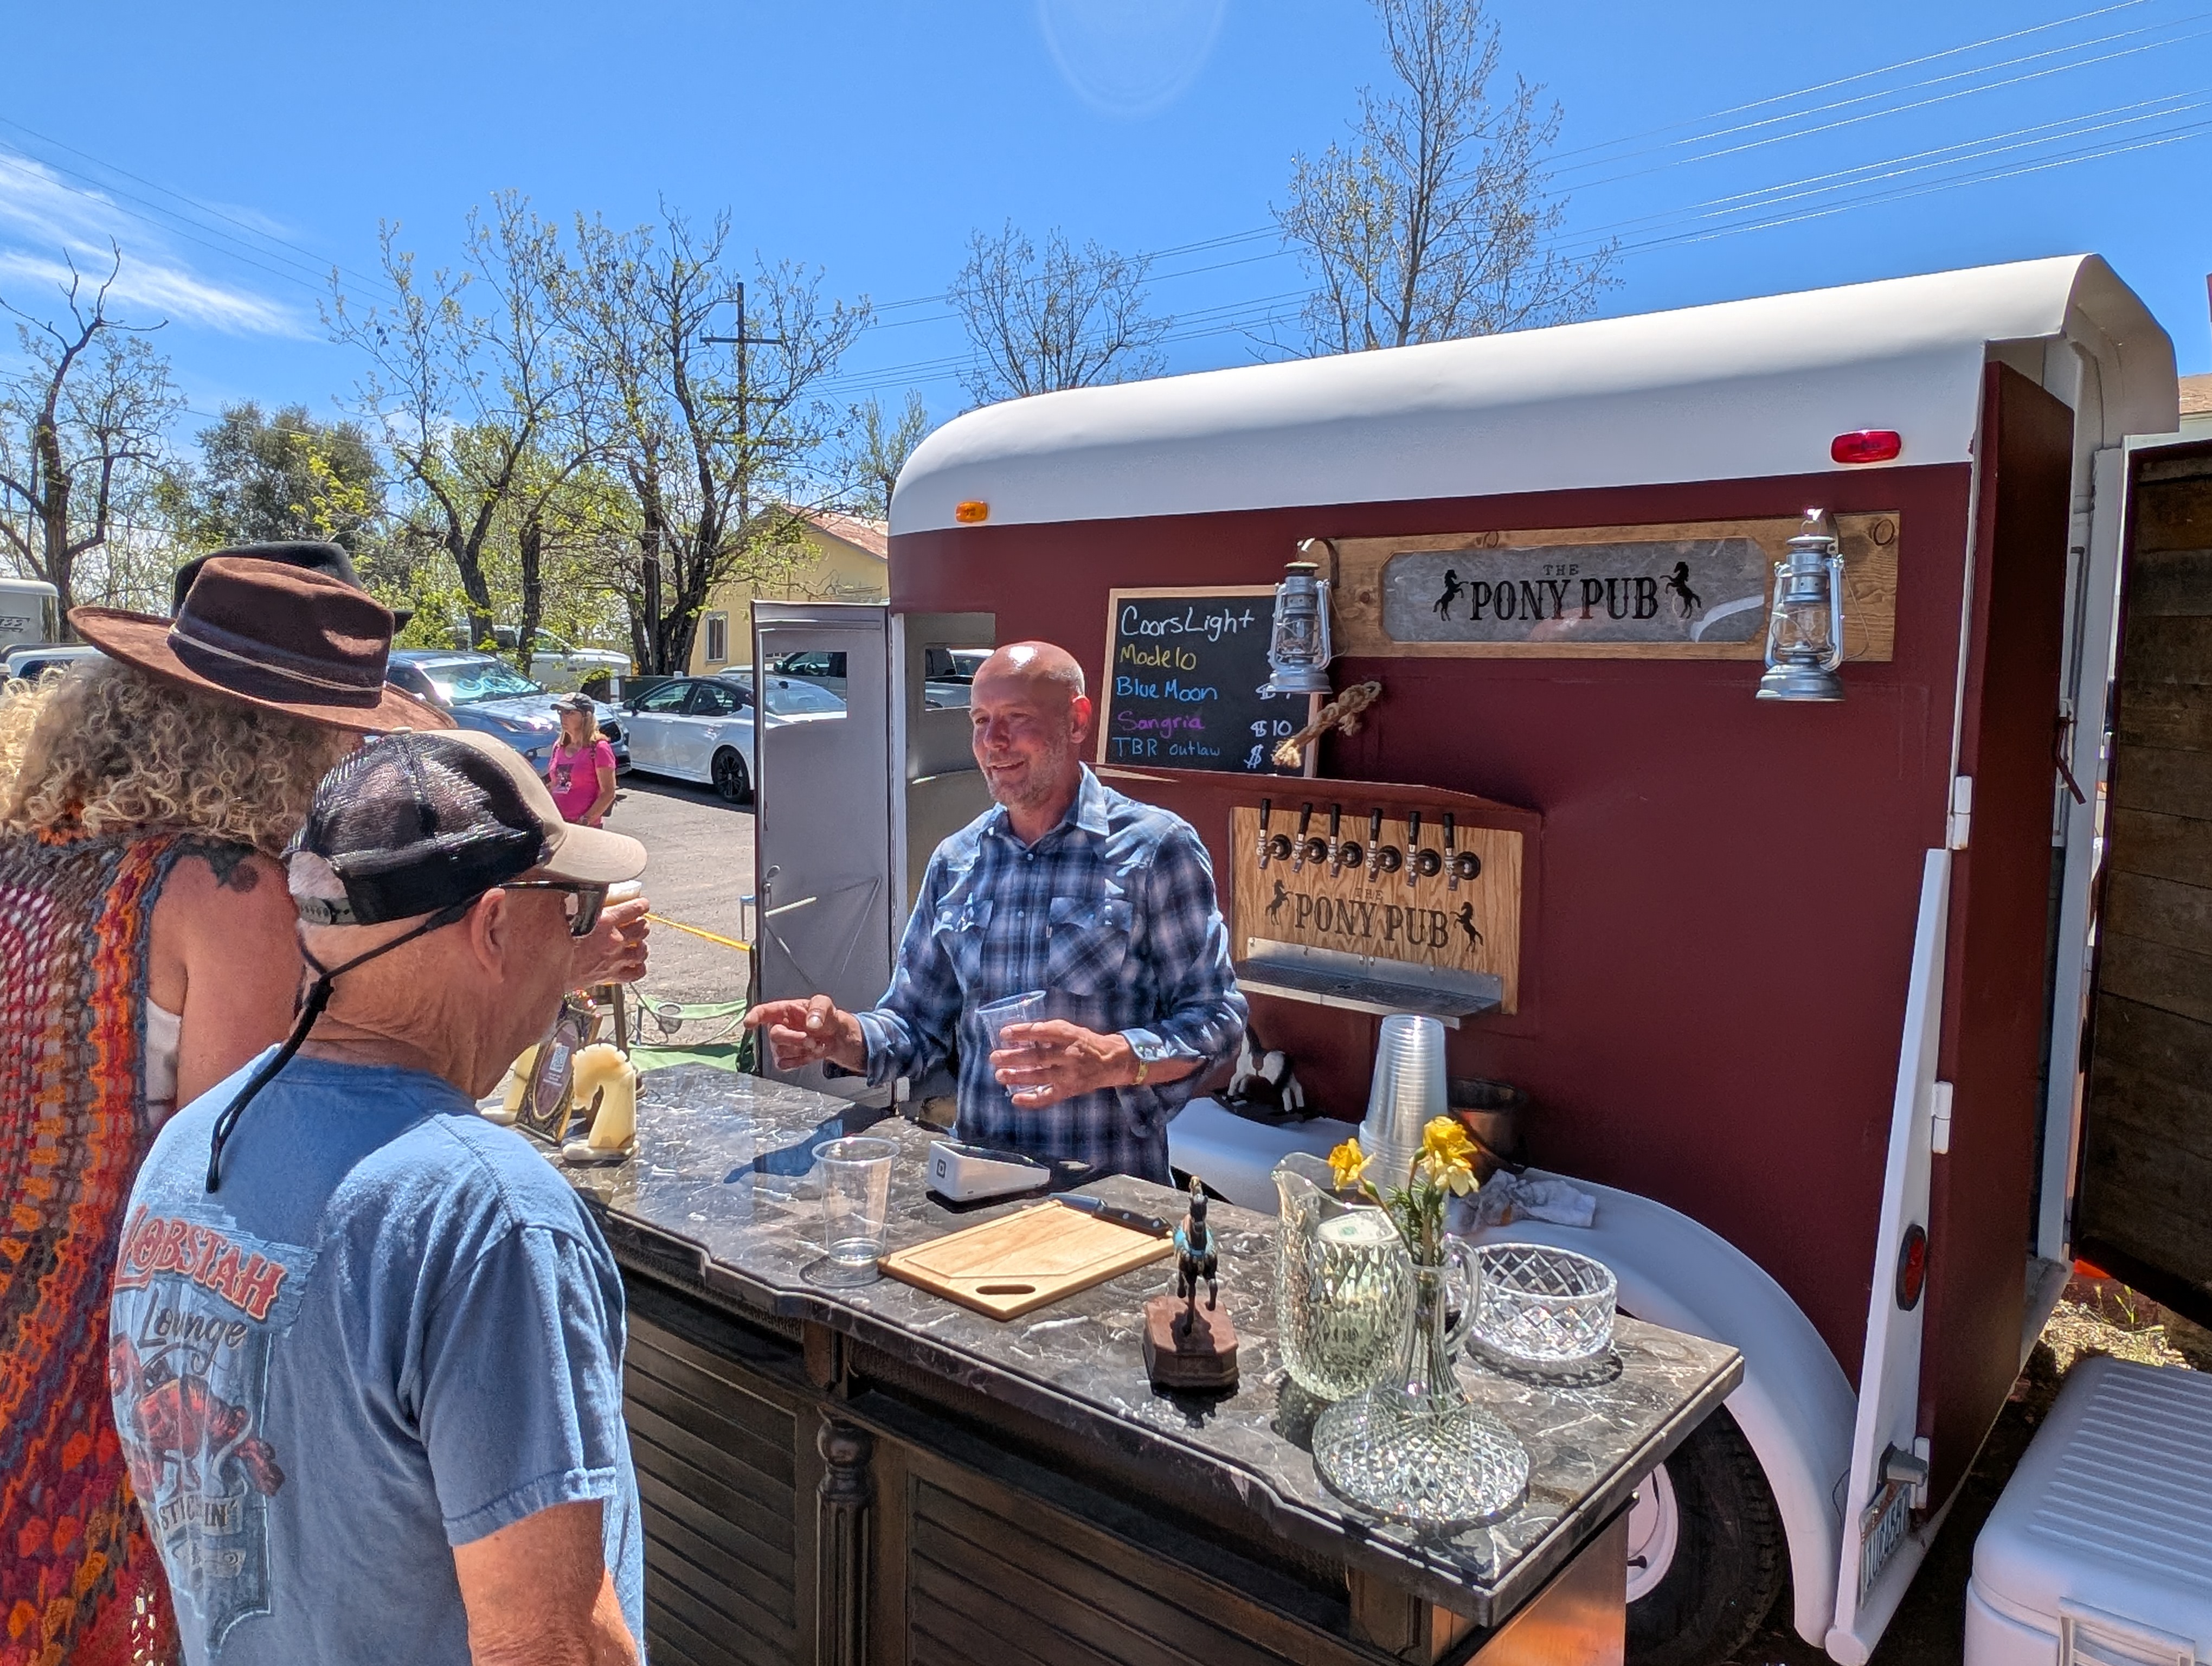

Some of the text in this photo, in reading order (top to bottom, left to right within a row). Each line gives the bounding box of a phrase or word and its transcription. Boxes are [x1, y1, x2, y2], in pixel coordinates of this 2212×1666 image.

[1543, 563, 1579, 576] THE
[1469, 576, 1659, 621] PONY PUB
[1184, 606, 1255, 642] Light
[1119, 643, 1197, 671] Modelo
[1116, 676, 1160, 699] Blue
[1164, 678, 1218, 702] Moon
[1117, 710, 1206, 739] Sangria
[1111, 736, 1158, 758] TBR
[1355, 888, 1383, 901] THE
[1295, 893, 1449, 949] PONY PUB
[114, 1203, 287, 1323] LOBSTAH
[137, 1286, 247, 1376] Lounge
